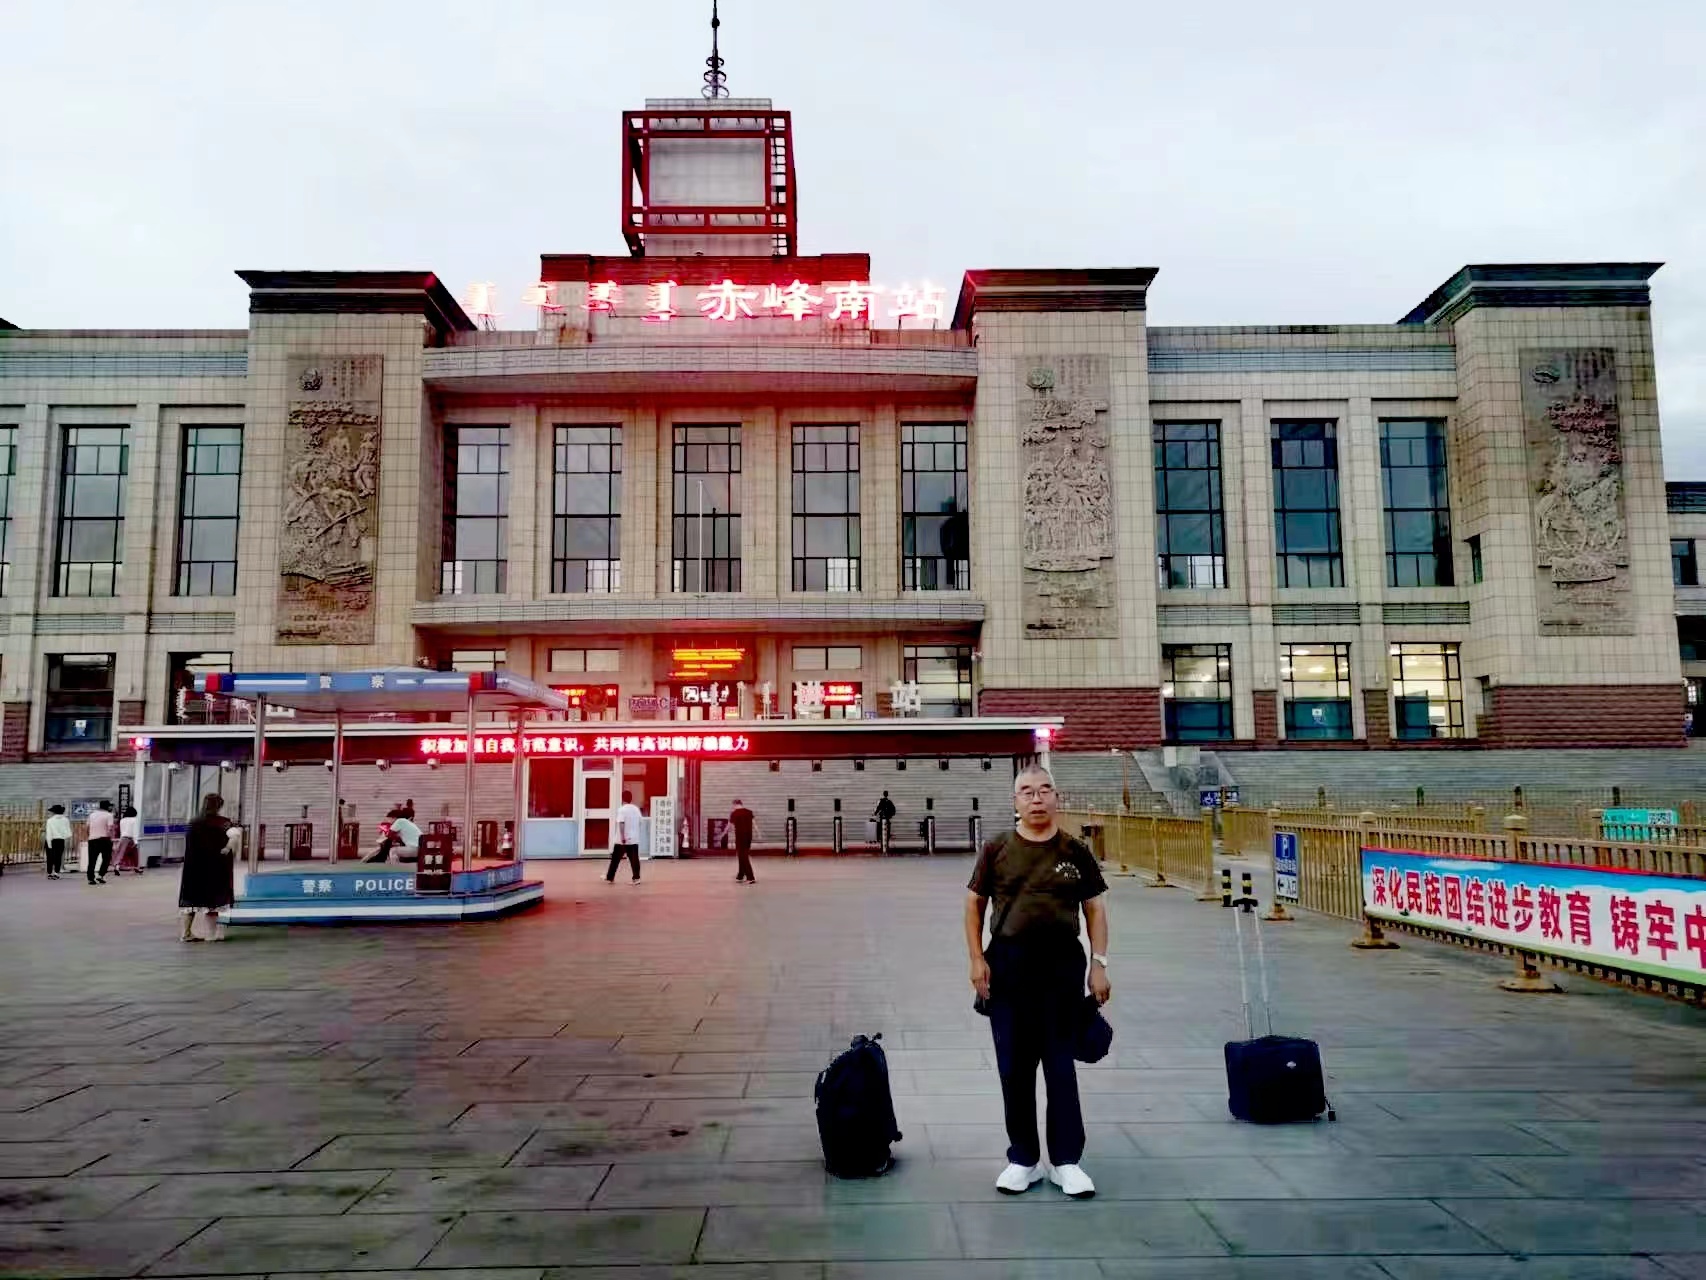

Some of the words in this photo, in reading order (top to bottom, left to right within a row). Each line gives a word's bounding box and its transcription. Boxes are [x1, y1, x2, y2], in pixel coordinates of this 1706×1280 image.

[696, 280, 947, 321] 赤峰南站
[302, 879, 332, 893] 警察
[355, 879, 415, 891] POLICE
[1371, 866, 1592, 945] 深化民族团结进步教育
